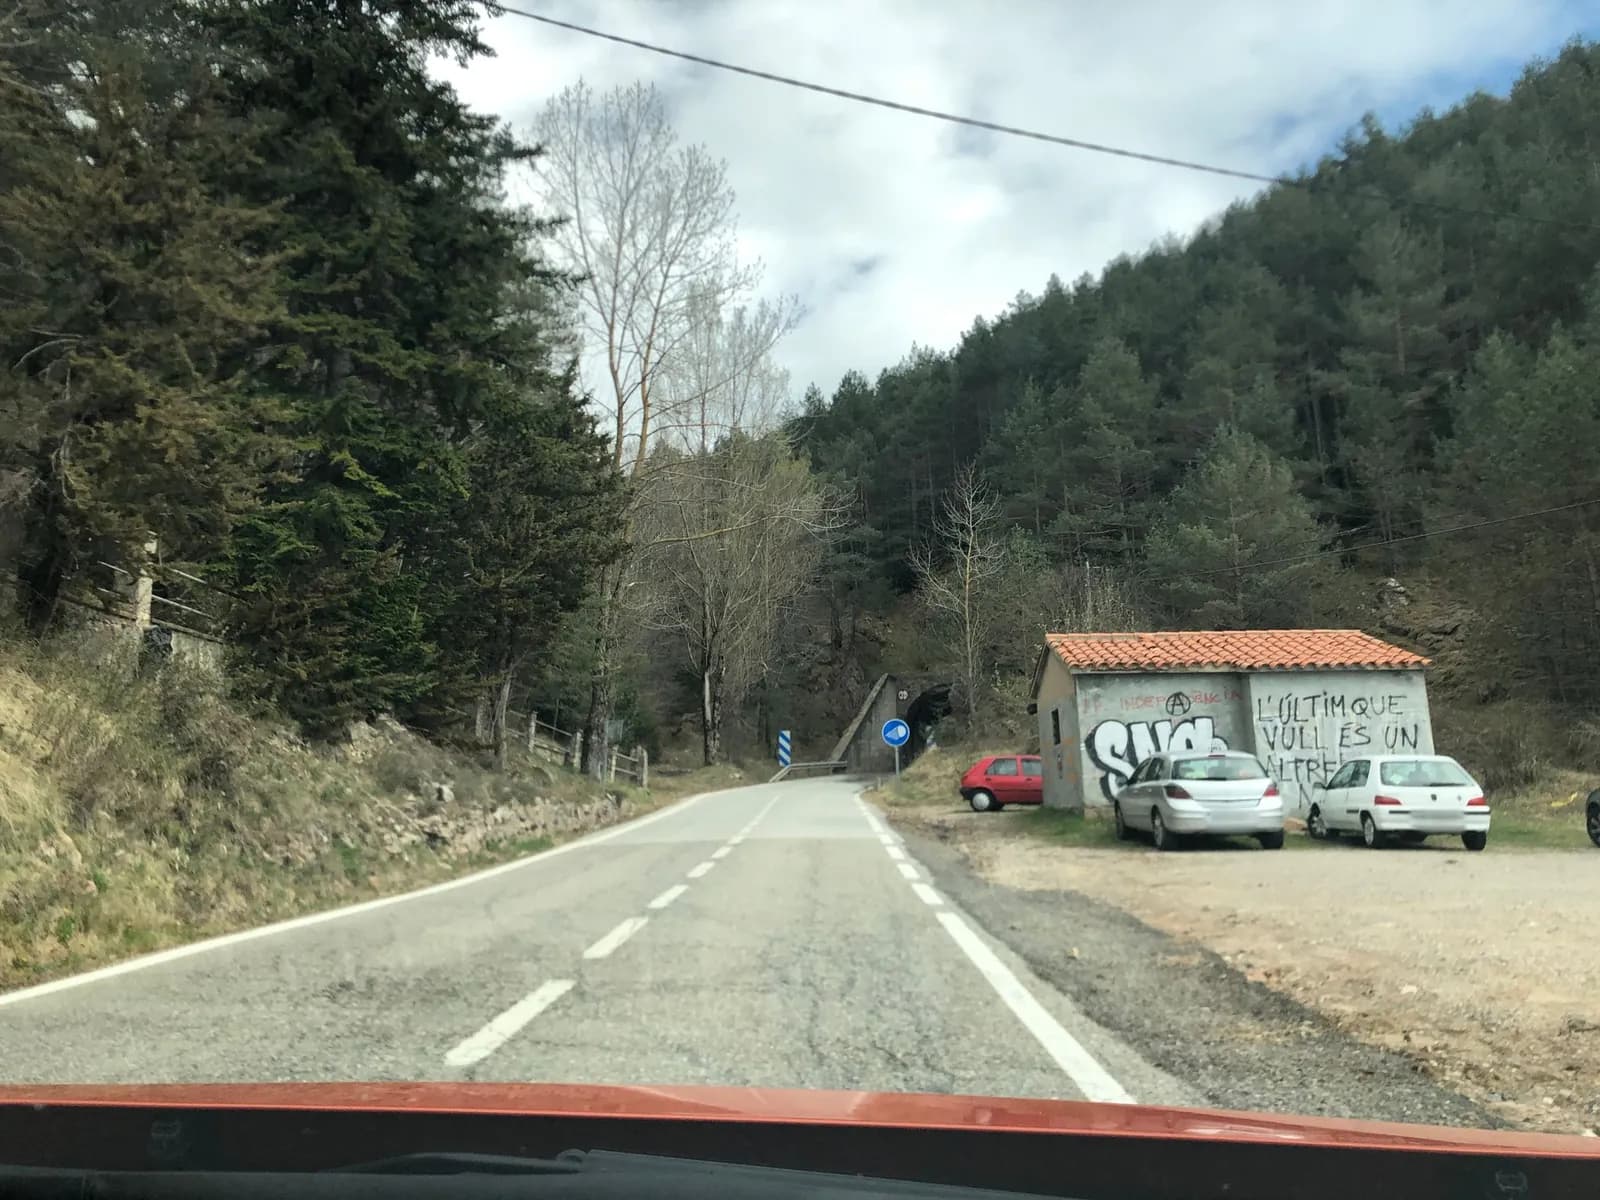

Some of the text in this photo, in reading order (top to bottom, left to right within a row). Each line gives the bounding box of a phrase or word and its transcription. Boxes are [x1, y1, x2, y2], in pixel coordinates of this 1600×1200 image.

[1351, 695, 1407, 719] QUE
[1263, 722, 1418, 750] VULL ÉS UN
